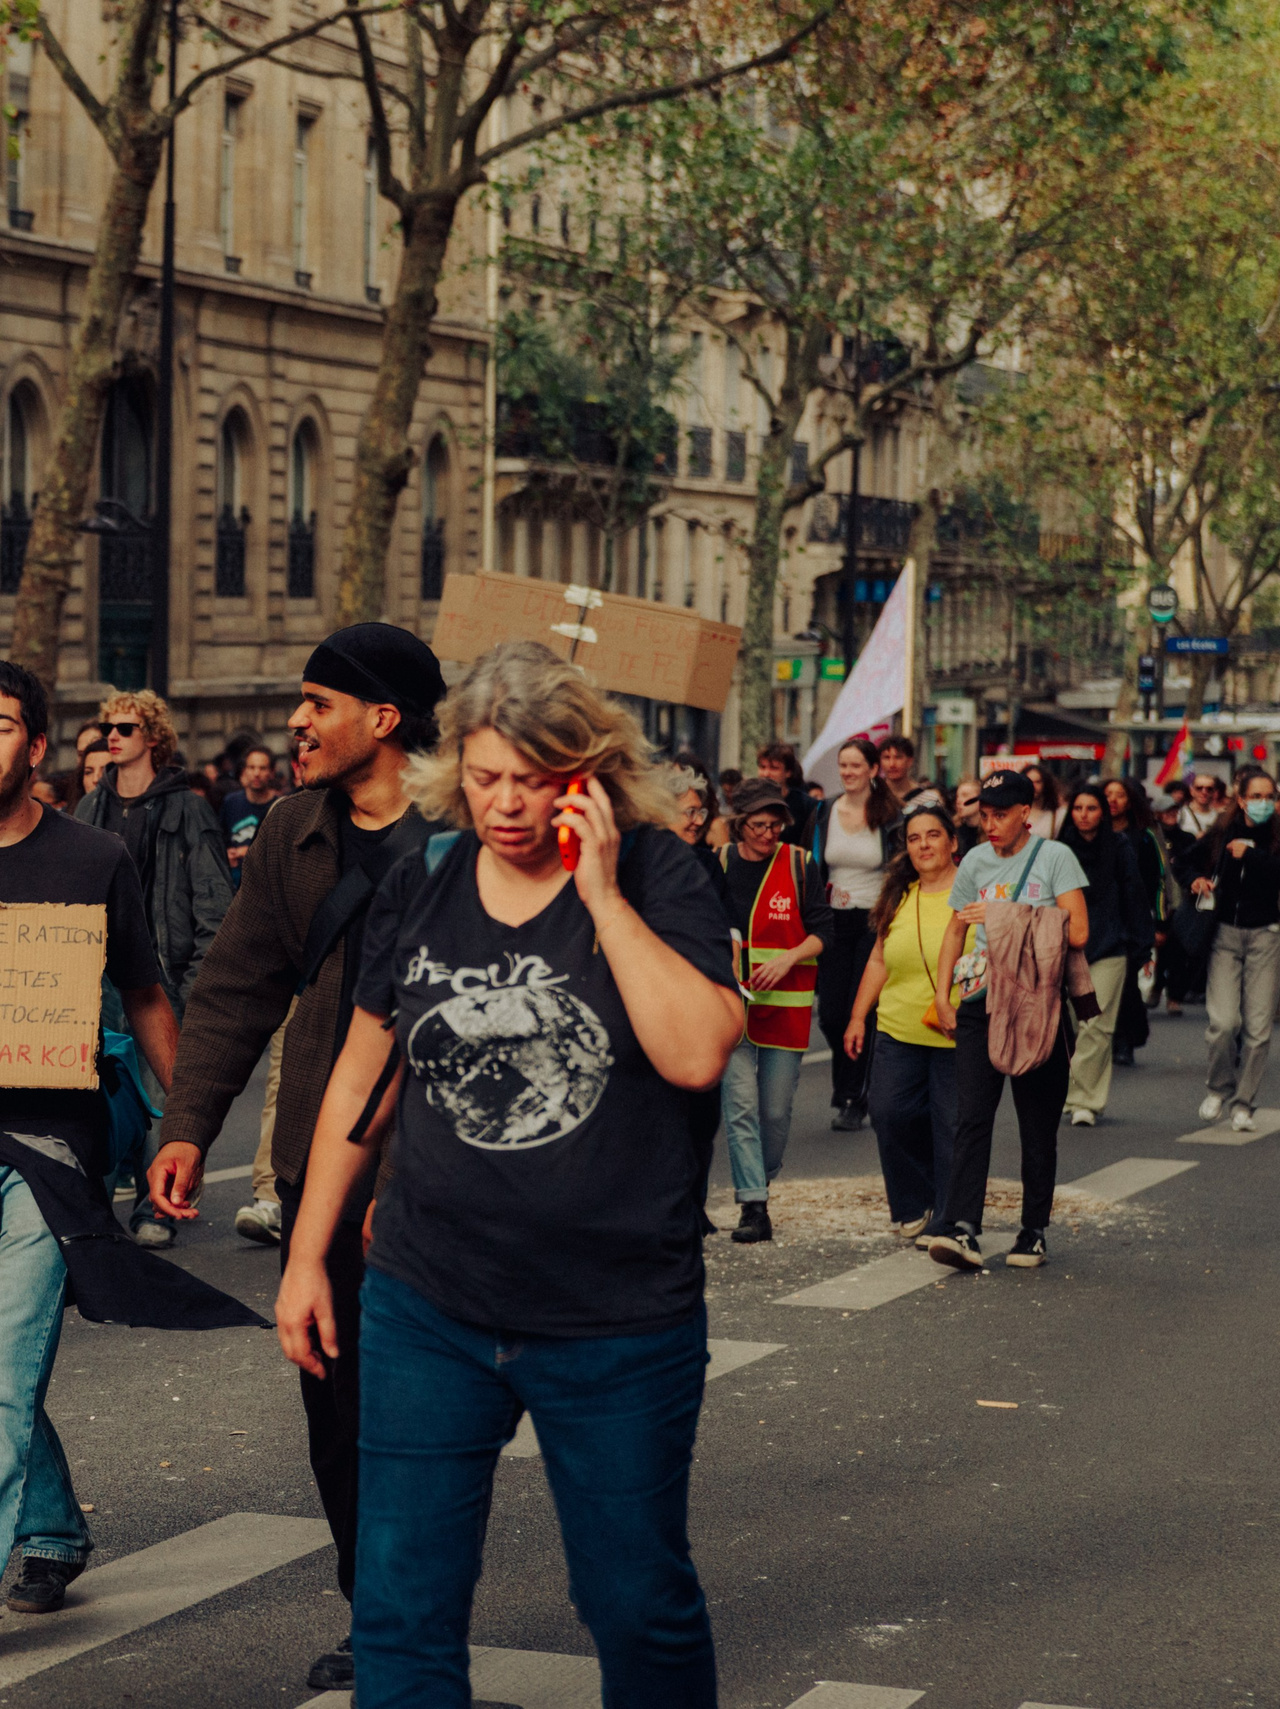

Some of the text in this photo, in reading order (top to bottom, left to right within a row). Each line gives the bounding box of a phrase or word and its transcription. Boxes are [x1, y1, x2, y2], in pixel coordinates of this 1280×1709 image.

[1150, 590, 1176, 606] BUS
[769, 896, 791, 912] cgt
[768, 912, 790, 921] PARIS
[18, 924, 103, 944] RATION
